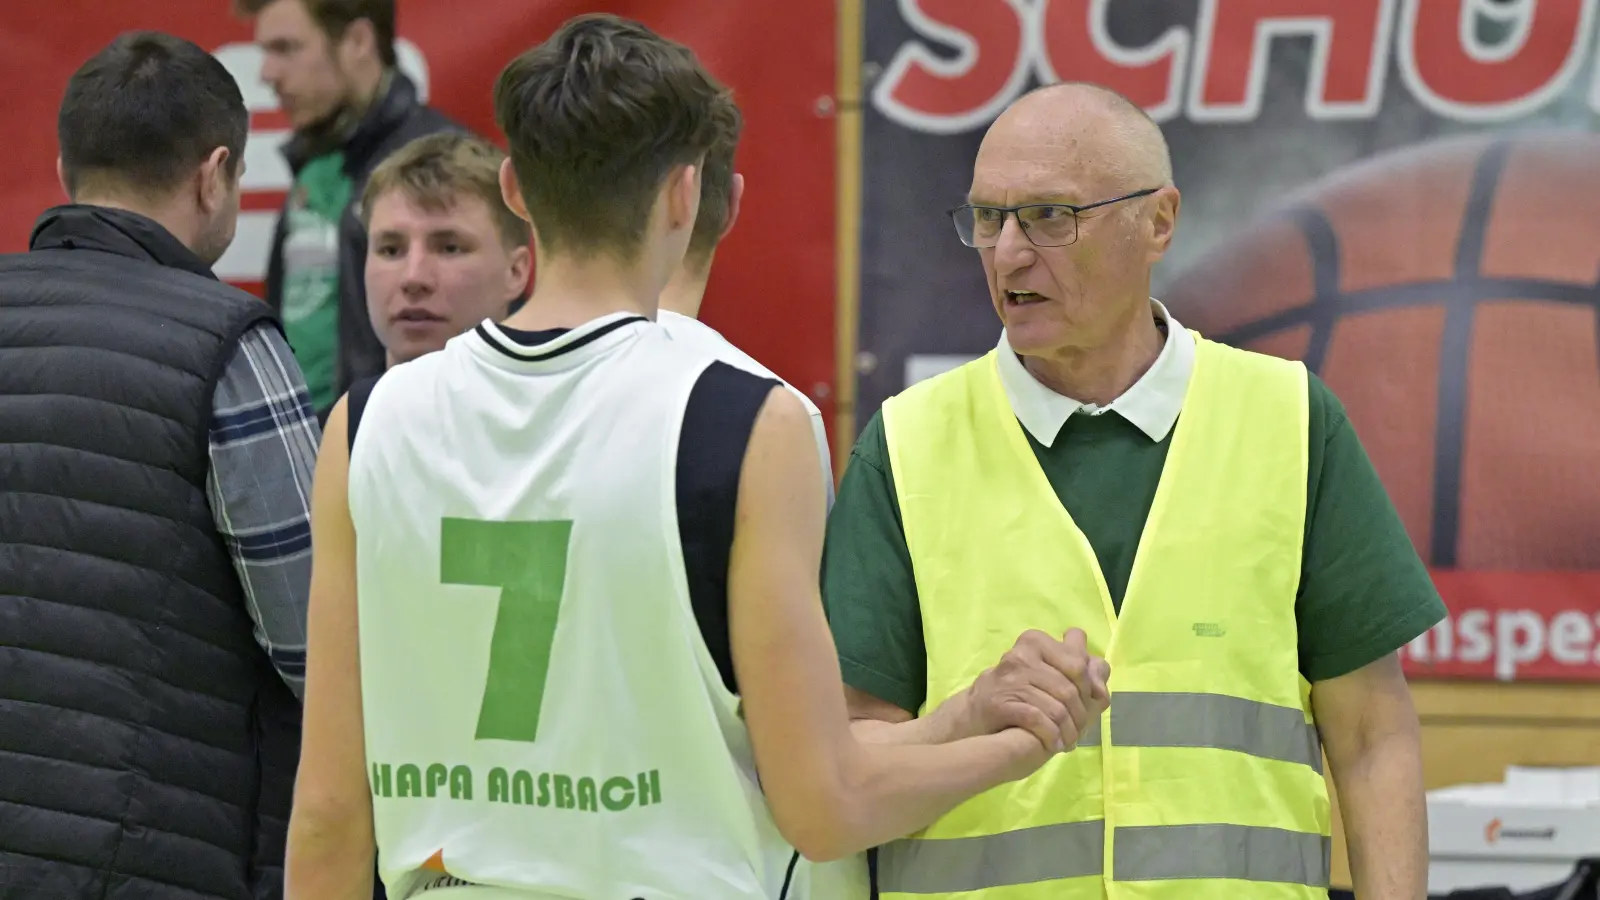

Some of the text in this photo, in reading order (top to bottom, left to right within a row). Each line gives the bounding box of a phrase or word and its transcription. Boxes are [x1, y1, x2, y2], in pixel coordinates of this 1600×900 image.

[440, 517, 574, 742] 7
[1398, 608, 1600, 681] nspe
[373, 762, 661, 812] HAPA ANSBACH
